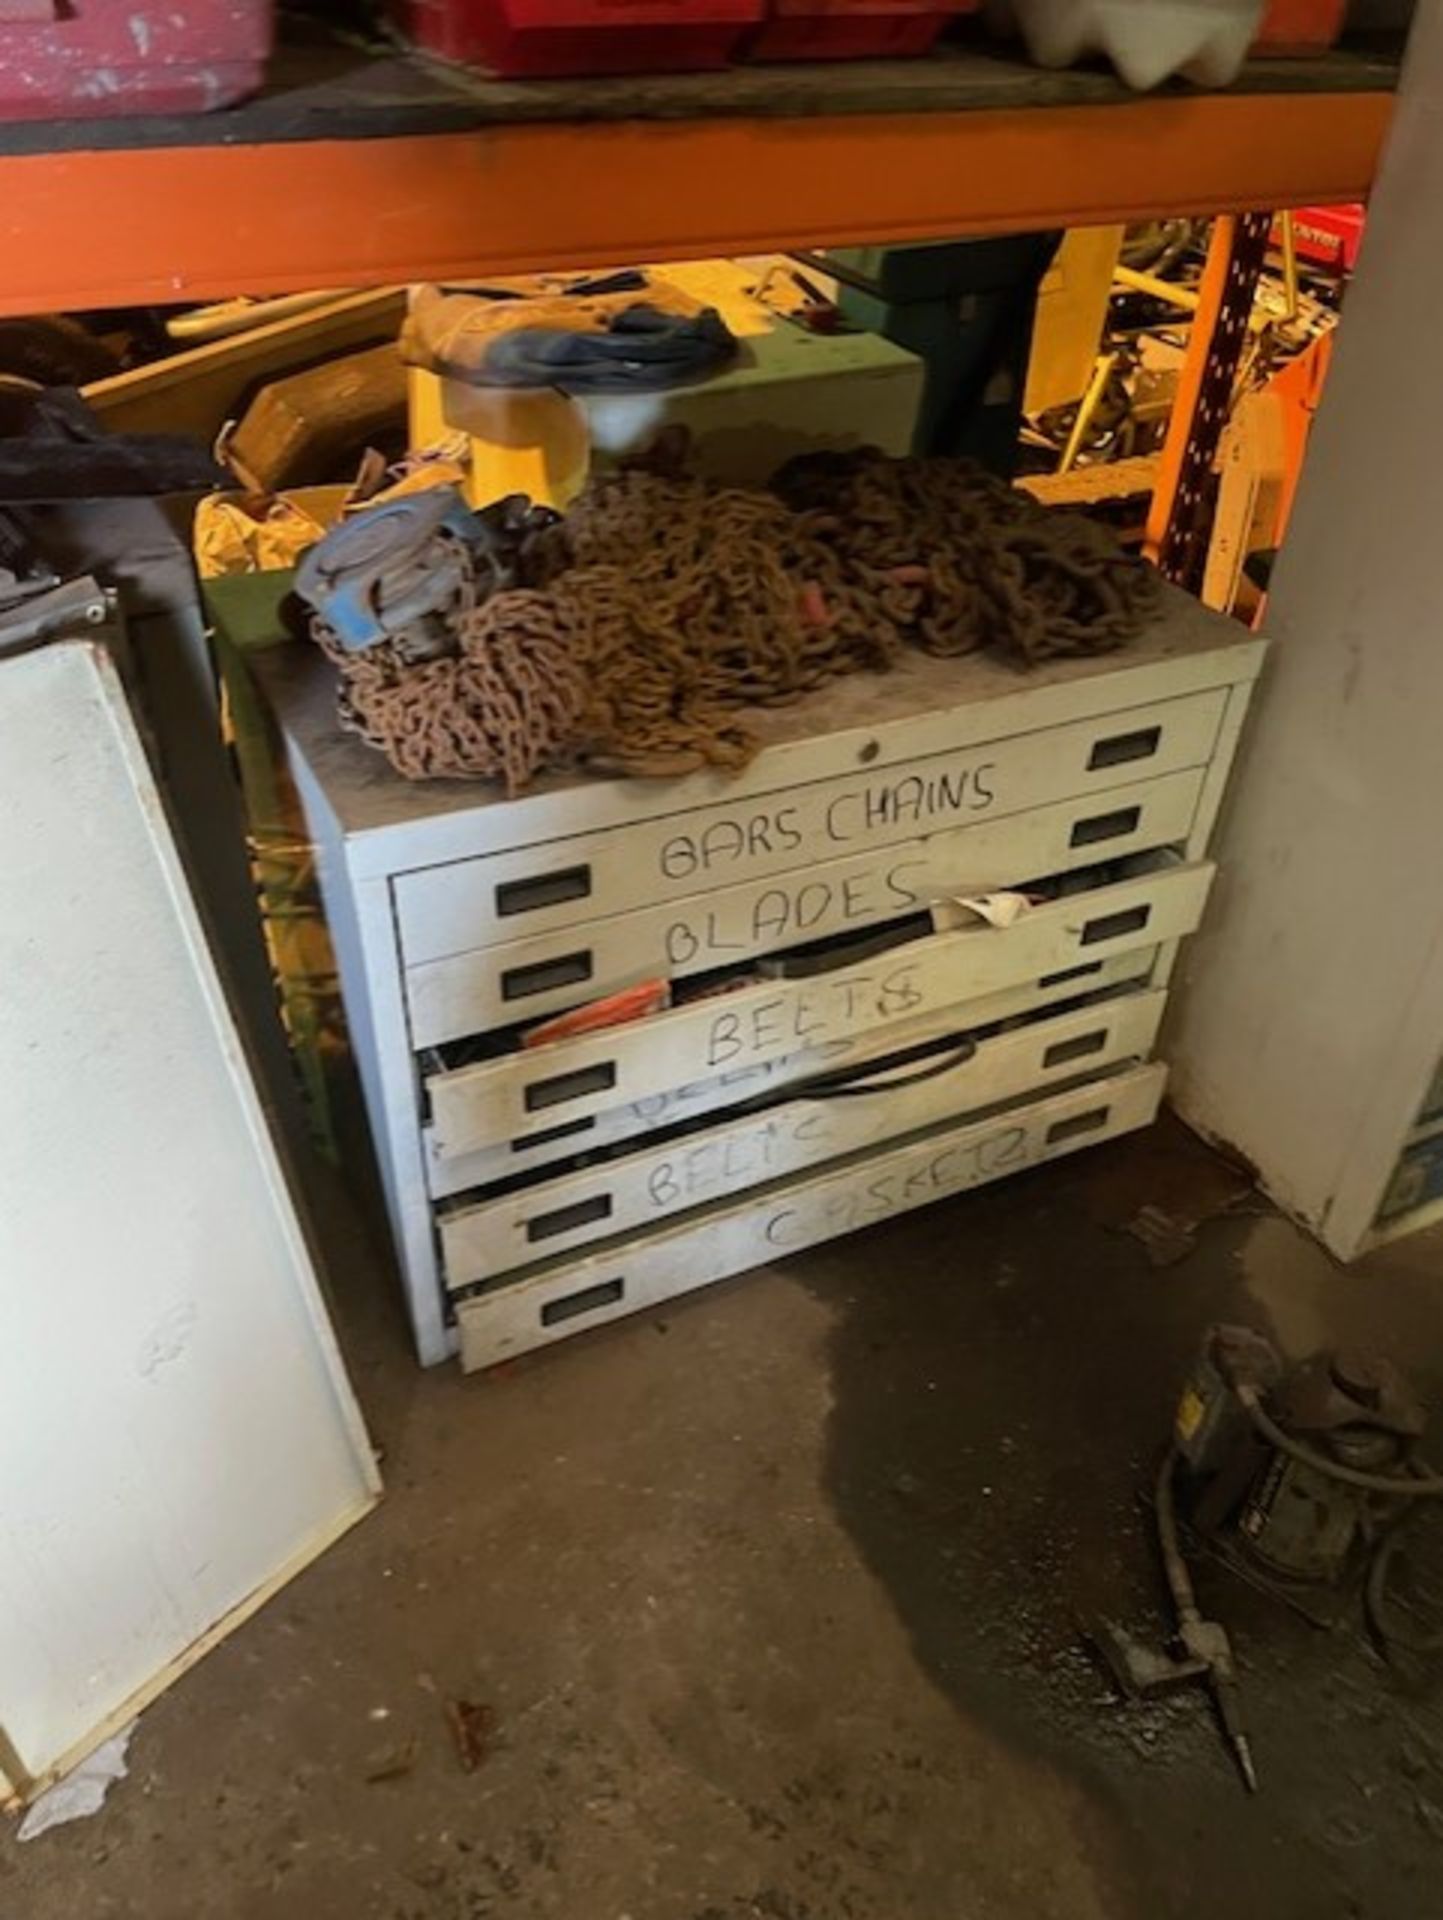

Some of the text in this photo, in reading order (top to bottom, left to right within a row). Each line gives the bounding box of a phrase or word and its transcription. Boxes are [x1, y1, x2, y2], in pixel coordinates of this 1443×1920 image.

[659, 763, 998, 880] BARS CHAINS
[665, 859, 929, 966] BLADES
[707, 963, 923, 1067] BELTS
